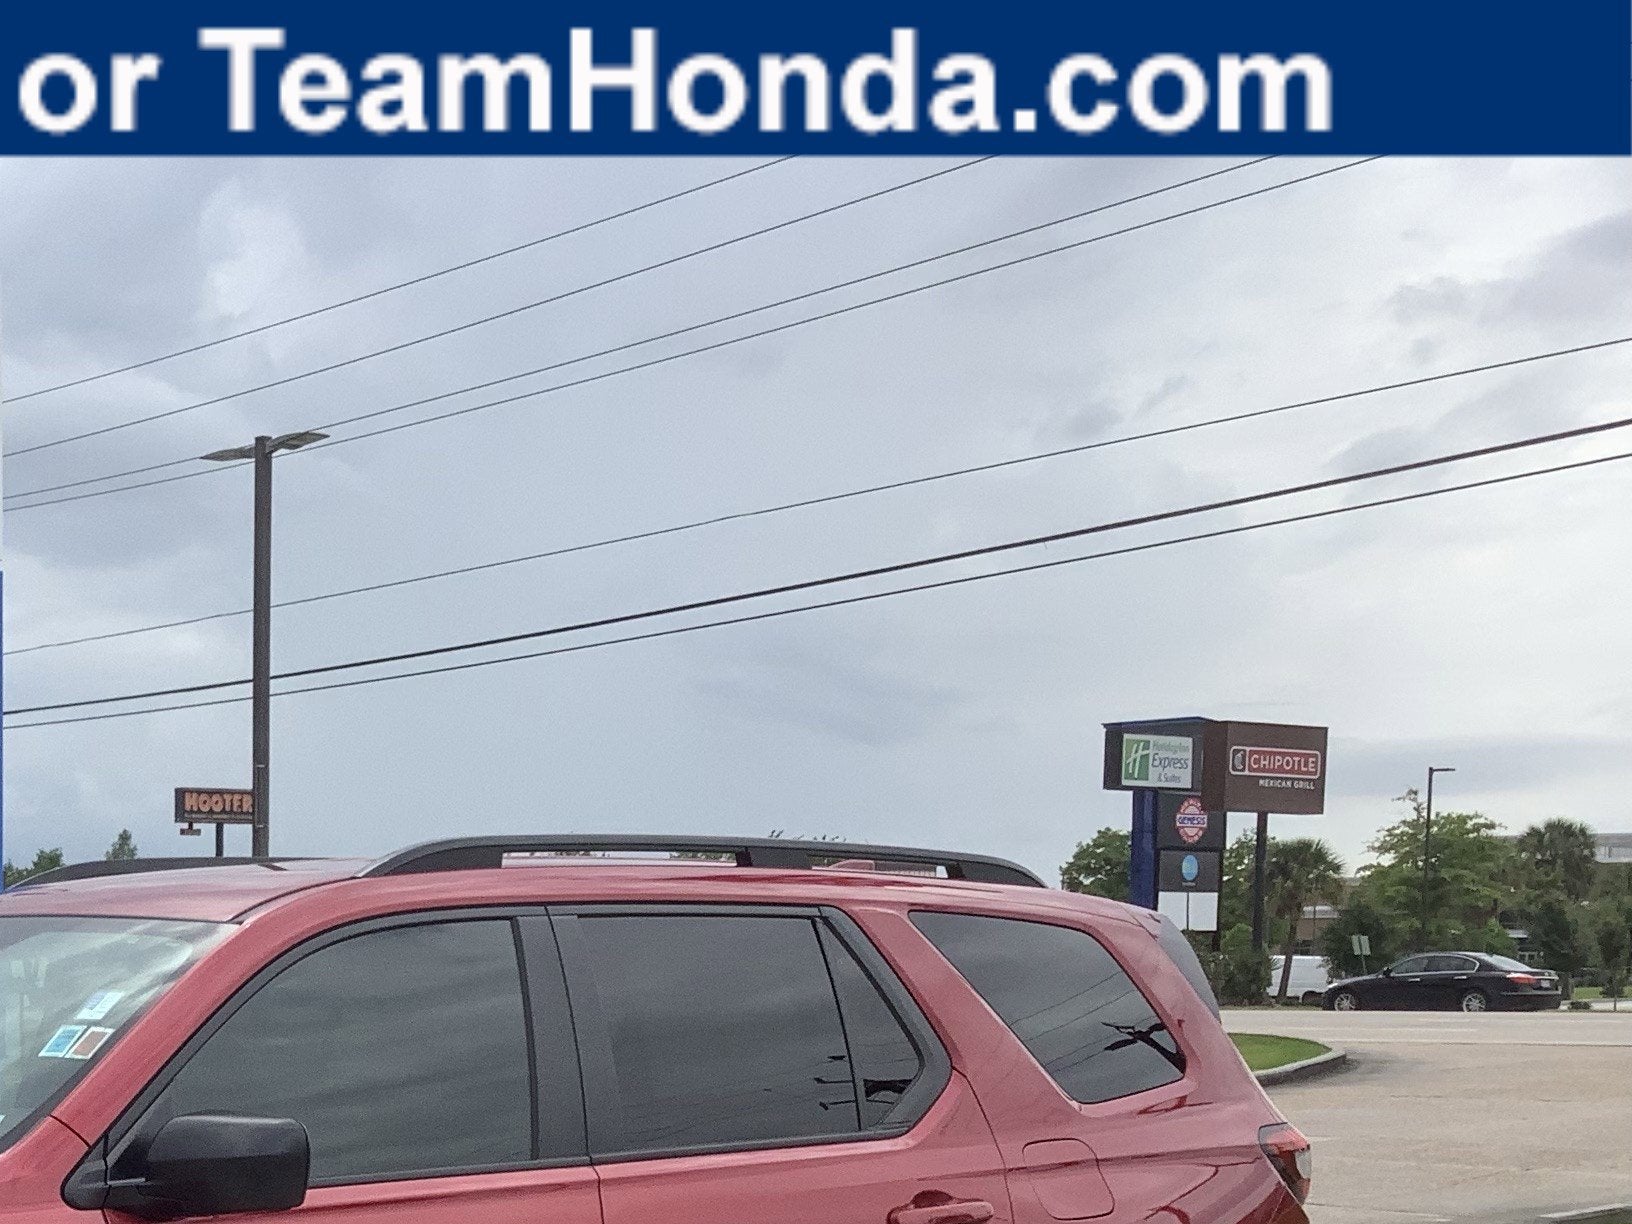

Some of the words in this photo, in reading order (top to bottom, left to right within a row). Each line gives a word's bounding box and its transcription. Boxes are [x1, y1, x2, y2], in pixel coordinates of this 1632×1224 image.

[1151, 752, 1189, 772] Express
[1250, 754, 1316, 772] CHIPOTLE
[1258, 779, 1292, 788] MEXICAN
[1293, 781, 1315, 790] GRILL
[184, 792, 253, 812] HOOTER
